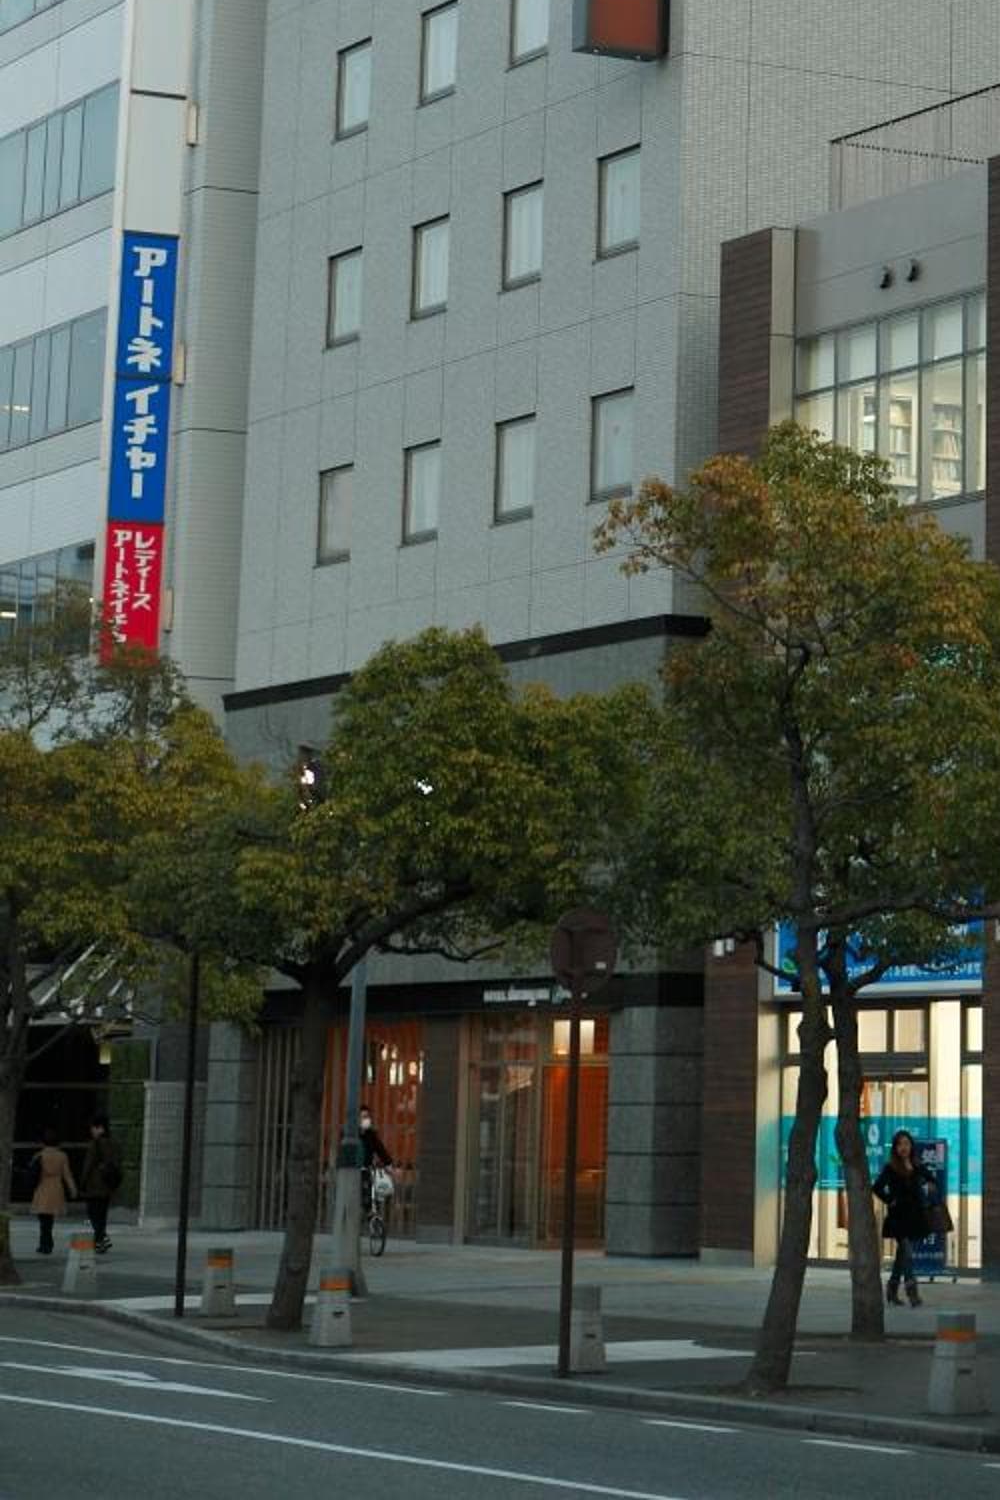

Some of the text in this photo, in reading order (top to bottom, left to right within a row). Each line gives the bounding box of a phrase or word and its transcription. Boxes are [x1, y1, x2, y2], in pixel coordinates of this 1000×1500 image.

[123, 245, 168, 499] アートネイチャー
[132, 531, 157, 611] レディース
